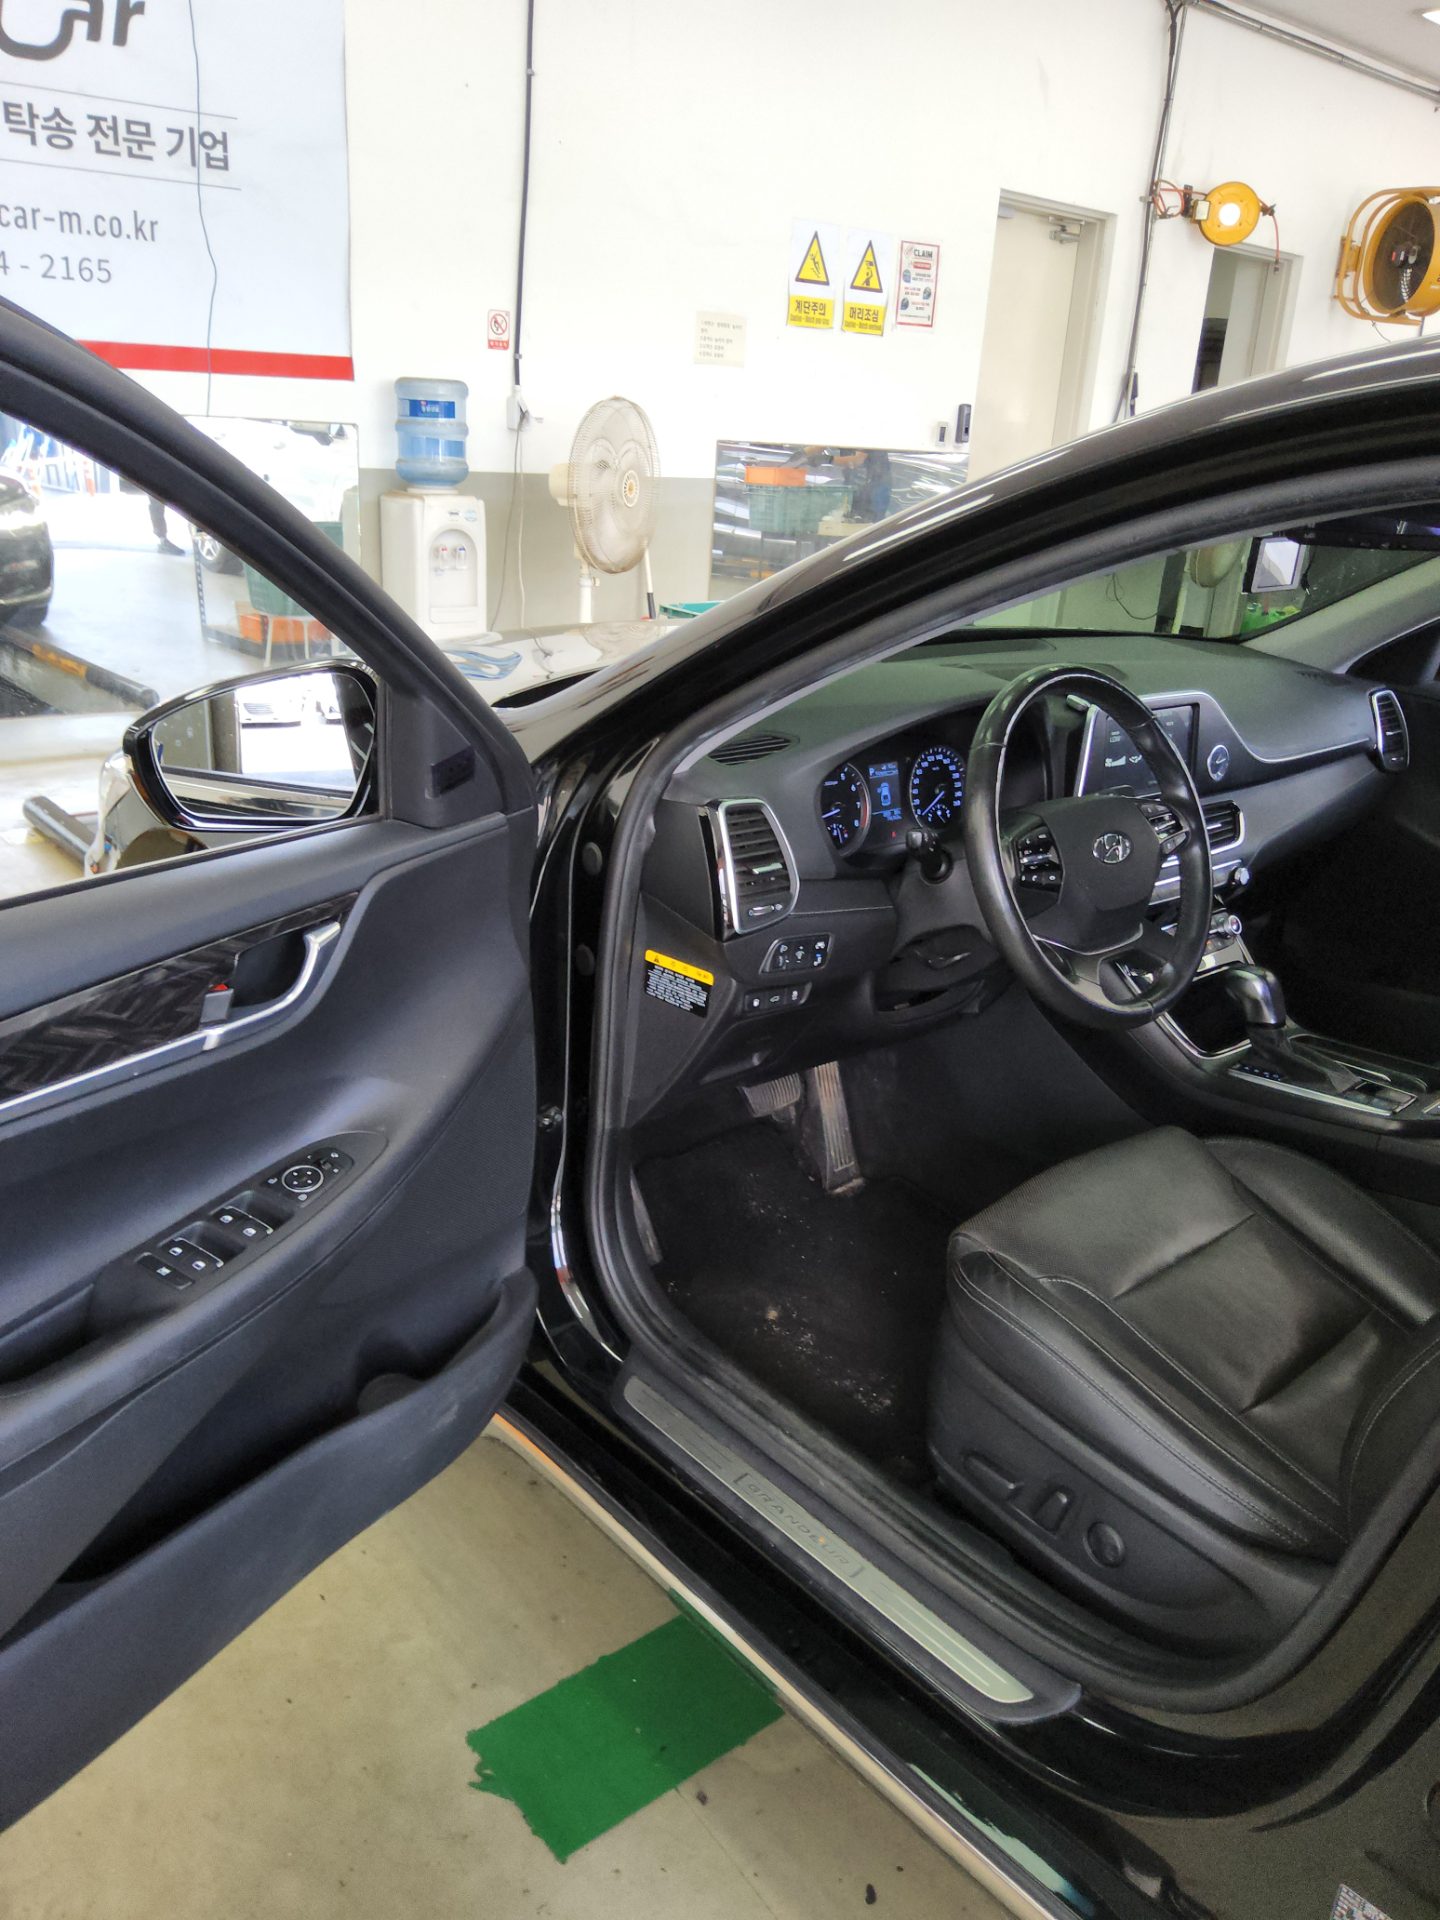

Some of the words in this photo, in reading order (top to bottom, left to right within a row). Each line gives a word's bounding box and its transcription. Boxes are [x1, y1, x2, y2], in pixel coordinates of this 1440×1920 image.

[3, 101, 77, 150] 탁송
[86, 113, 157, 161] 전문
[165, 126, 230, 171] 기업
[0, 203, 159, 242] car-m.co.kr
[913, 248, 933, 259] CLAIM
[40, 253, 113, 284] 2165
[795, 299, 826, 316] 계단주의
[850, 307, 879, 323] 머리조심
